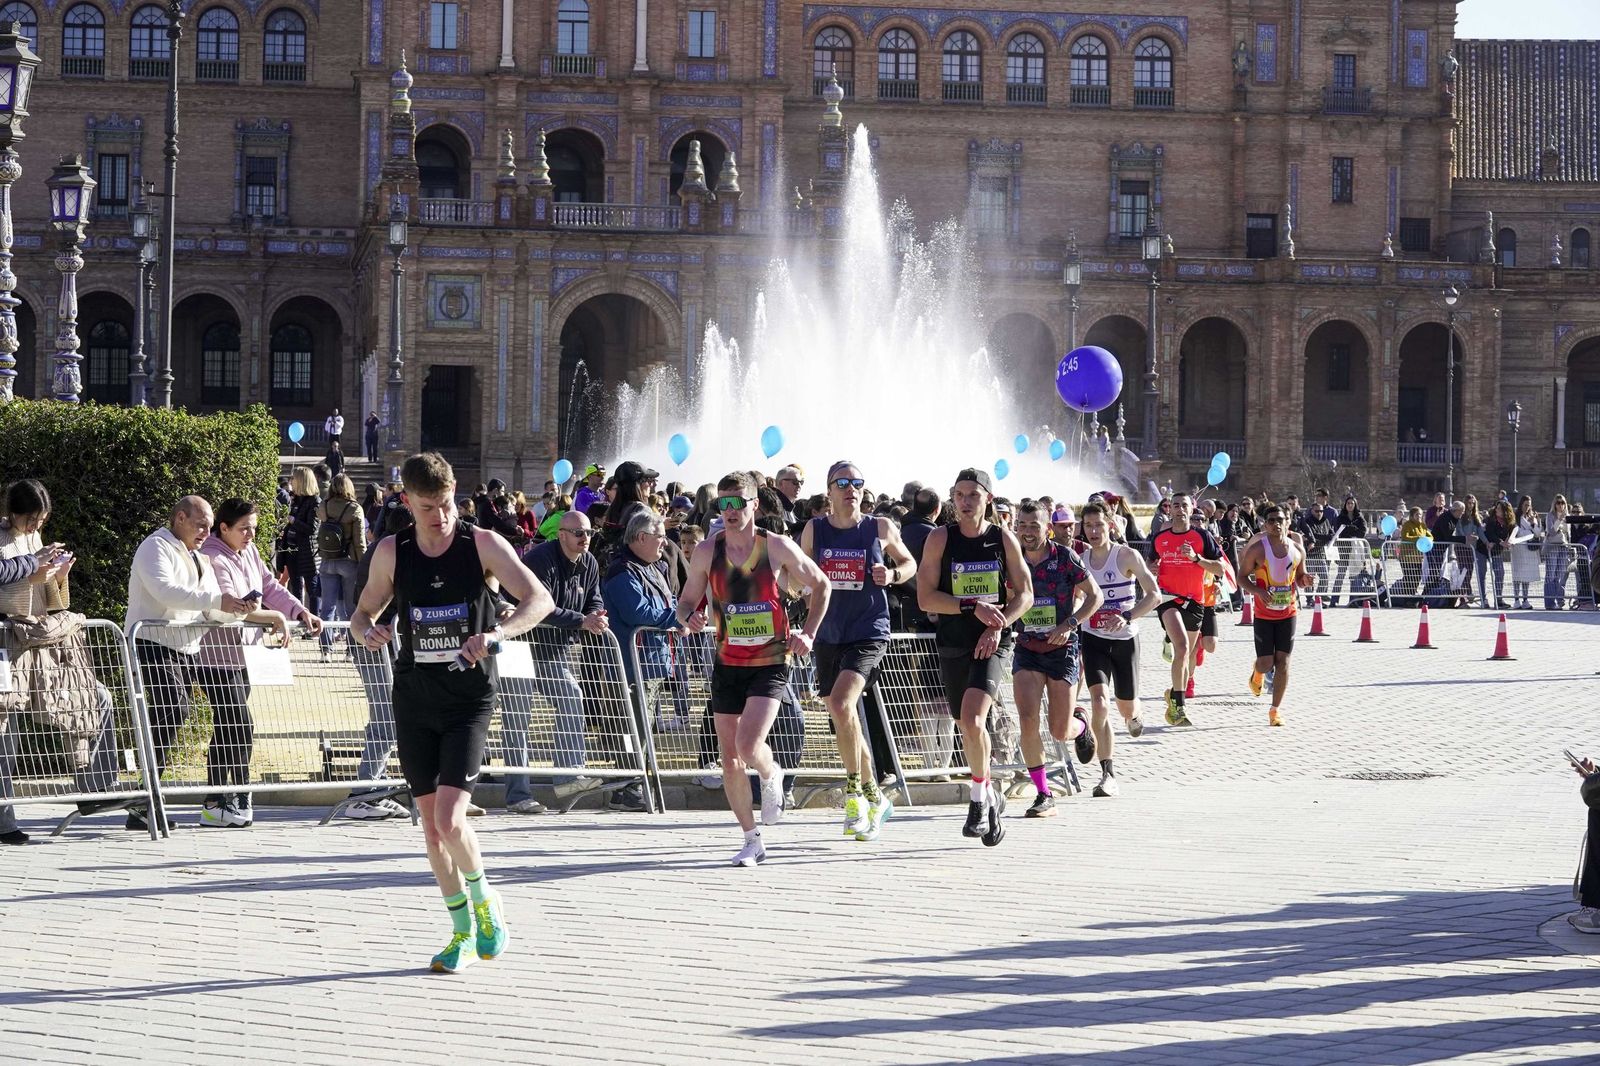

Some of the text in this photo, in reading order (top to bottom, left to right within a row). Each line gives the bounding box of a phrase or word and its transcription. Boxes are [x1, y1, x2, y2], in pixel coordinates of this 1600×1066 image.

[1061, 356, 1079, 376] 2:45
[967, 563, 994, 571] ZURICH
[827, 570, 856, 580] TOMAS
[963, 585, 989, 594] KEVIN
[1107, 589, 1115, 598] C
[739, 604, 766, 612] ZURICH
[426, 607, 460, 619] ZURICH
[428, 626, 447, 635] 3551
[732, 625, 767, 636] NATHAN
[419, 636, 460, 650] RONAN
